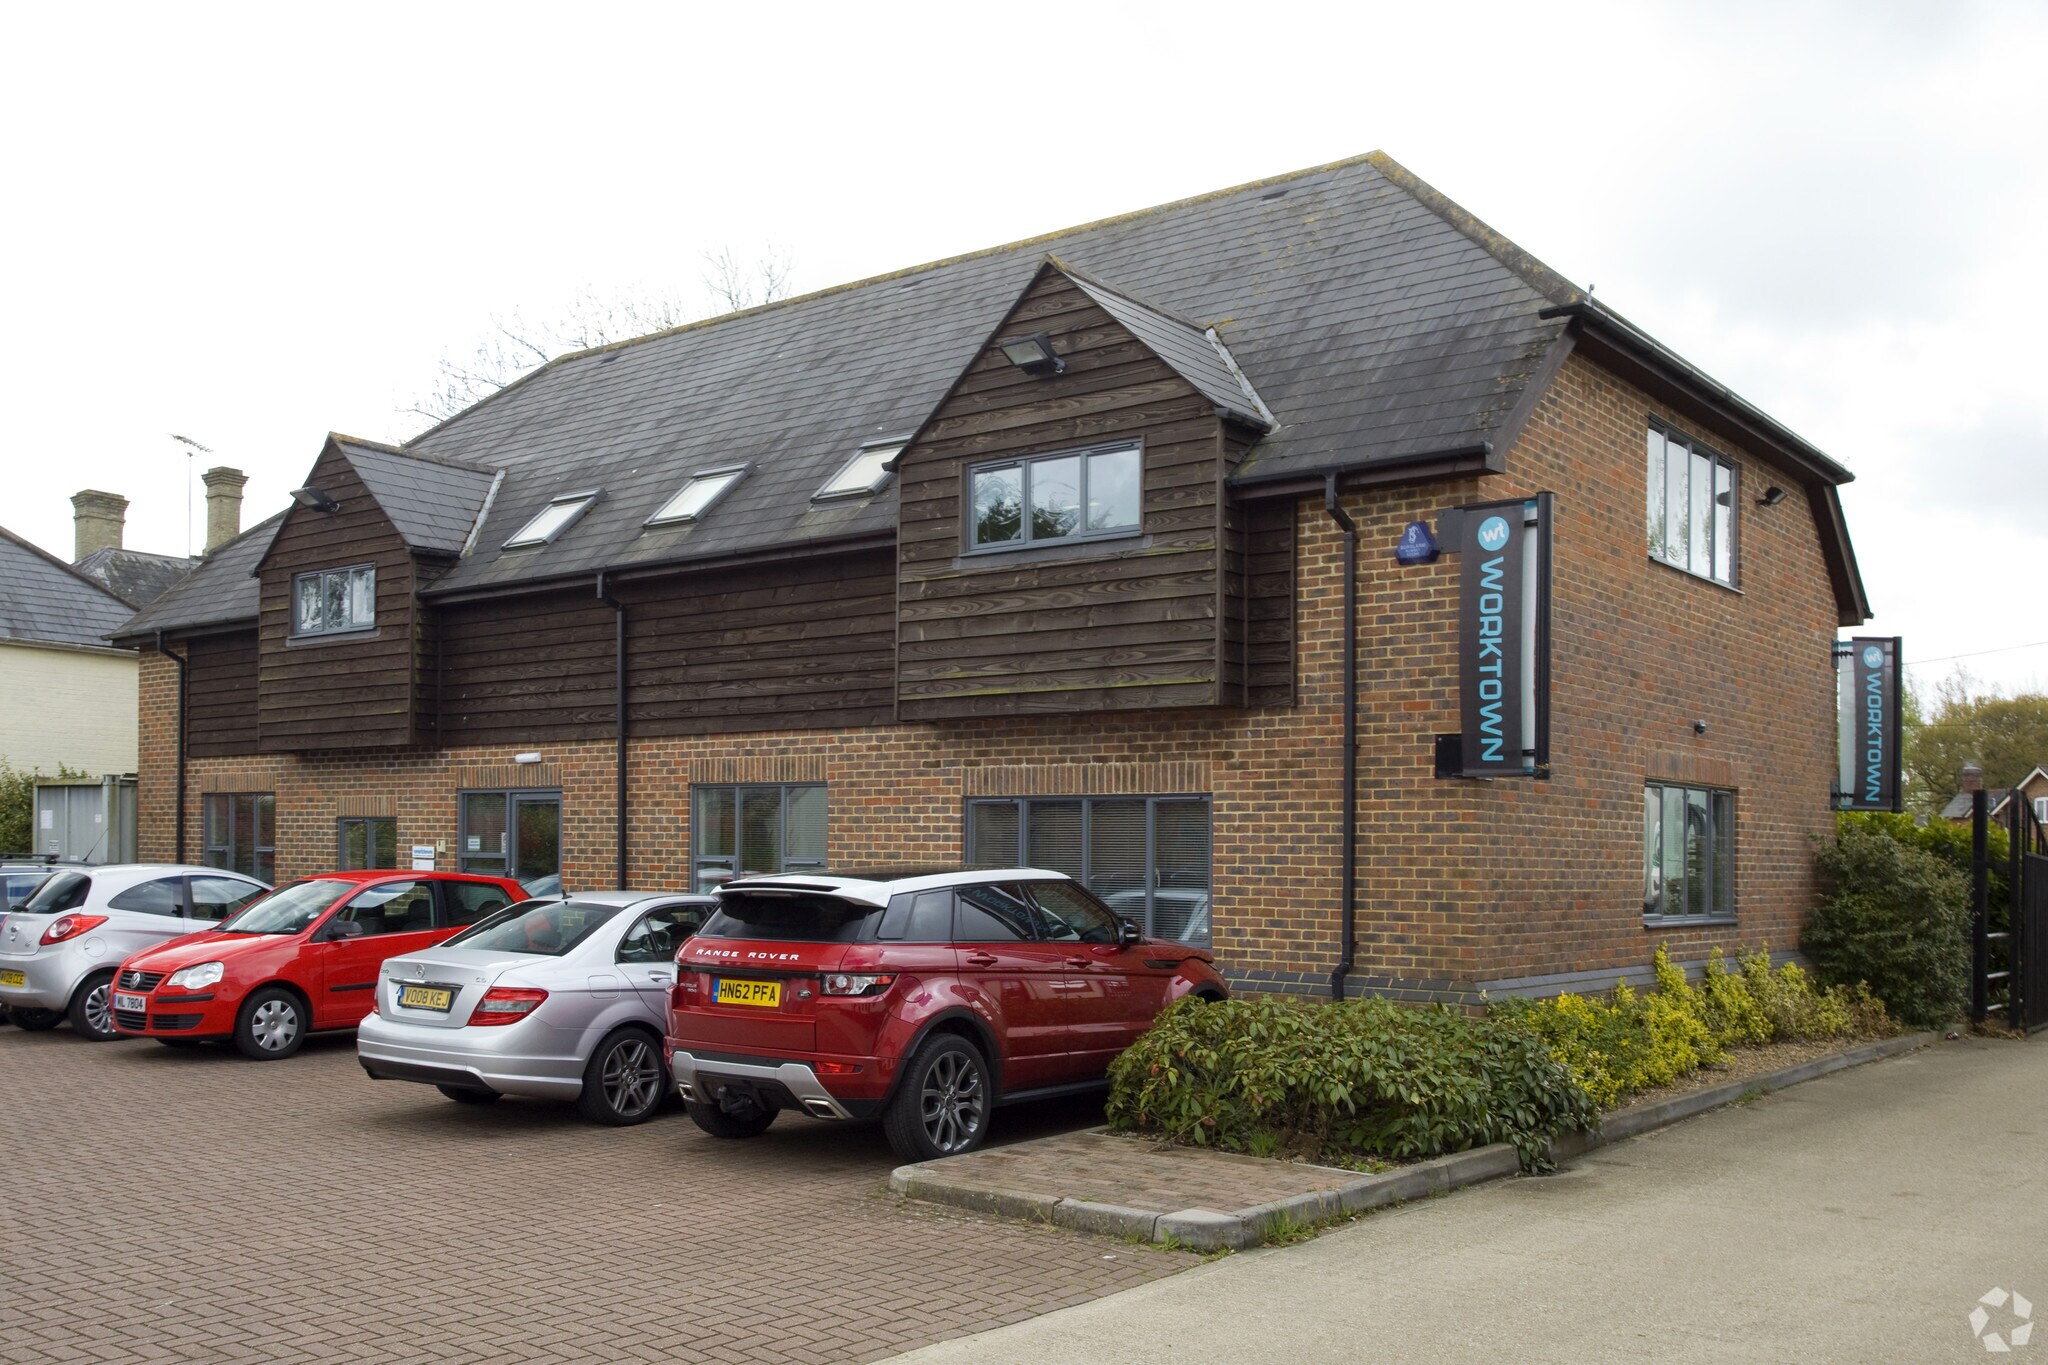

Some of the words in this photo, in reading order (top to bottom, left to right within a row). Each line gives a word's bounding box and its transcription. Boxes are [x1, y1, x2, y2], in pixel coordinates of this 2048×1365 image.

[1482, 522, 1505, 543] wt
[1479, 556, 1504, 762] WORKTOWN
[1865, 672, 1883, 802] WORKTOWN
[695, 949, 740, 958] RANGE
[747, 951, 800, 961] ROVER
[429, 990, 450, 1007] KEJ
[719, 982, 751, 1000] HN62
[752, 984, 776, 1002] PFA
[126, 996, 144, 1010] 7804
